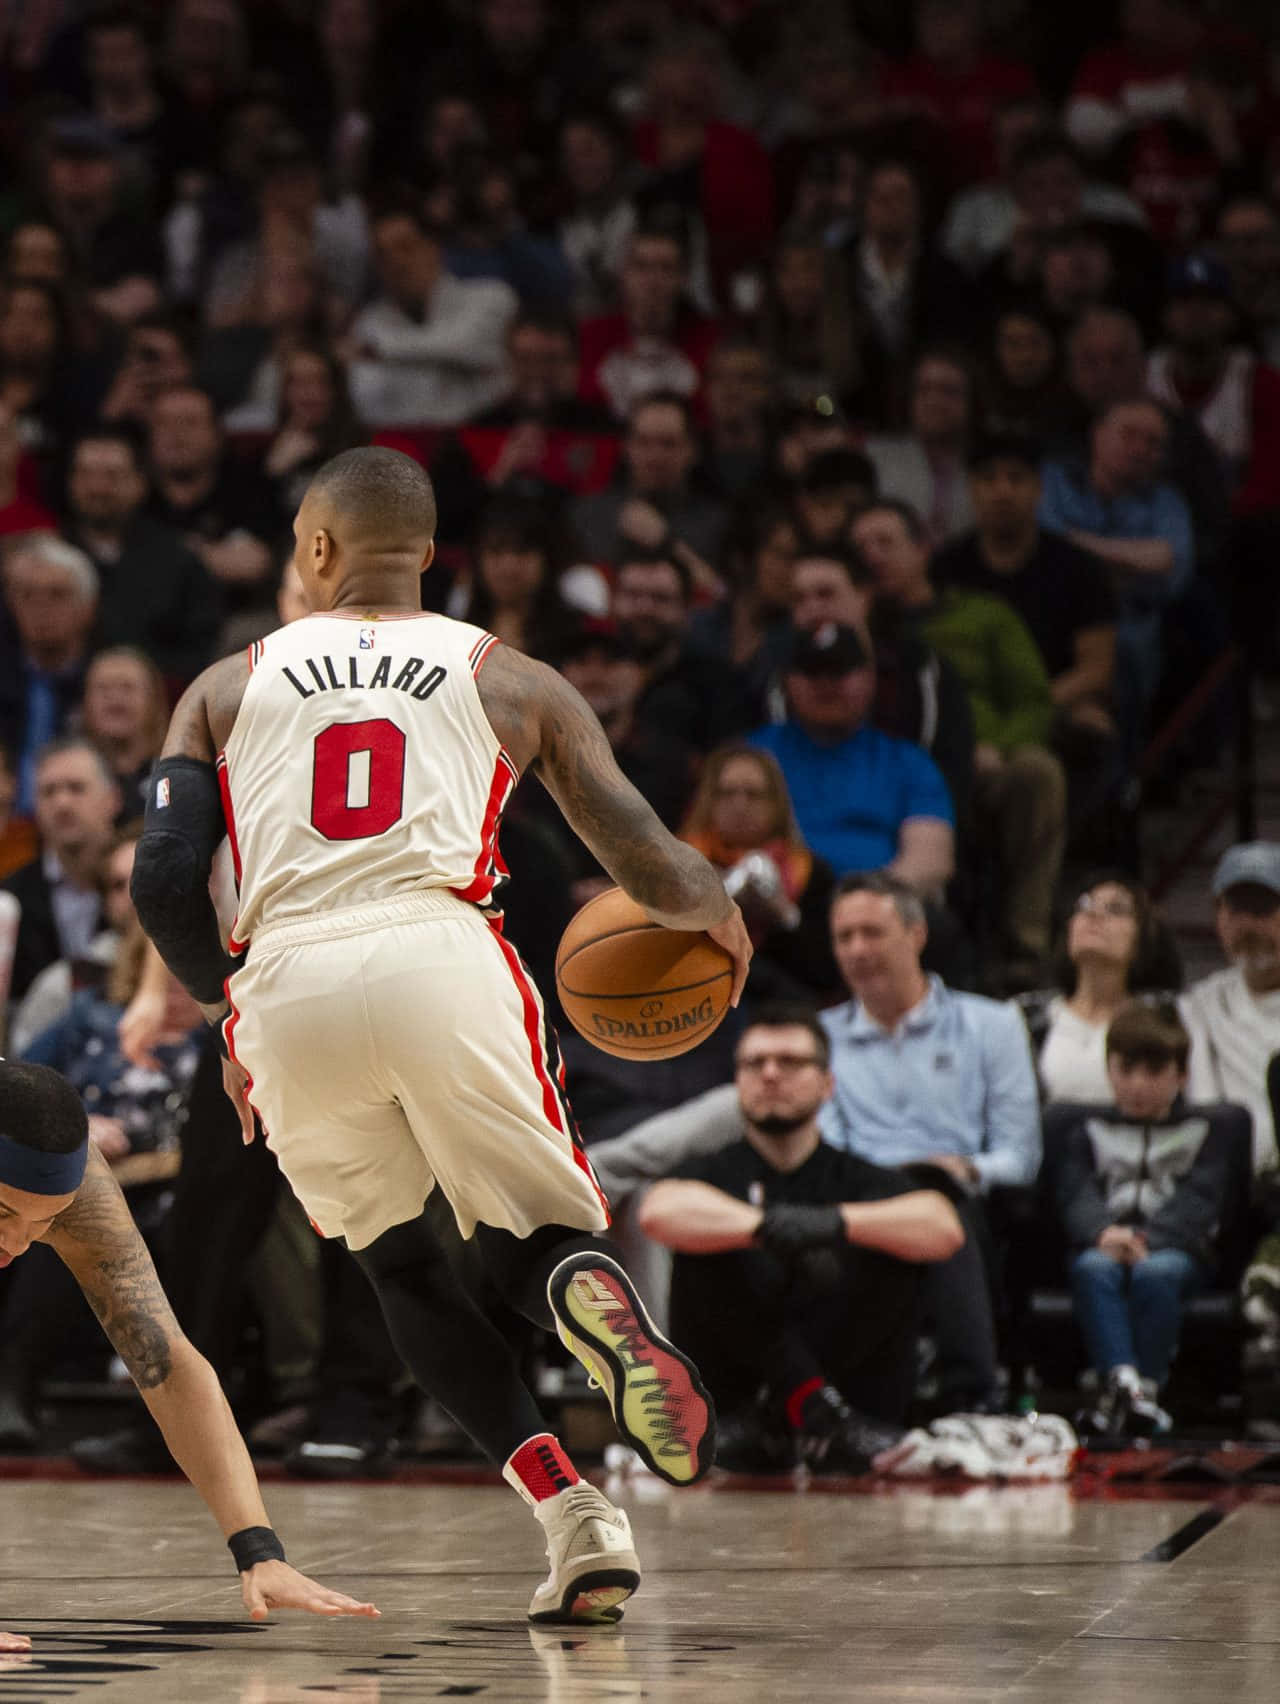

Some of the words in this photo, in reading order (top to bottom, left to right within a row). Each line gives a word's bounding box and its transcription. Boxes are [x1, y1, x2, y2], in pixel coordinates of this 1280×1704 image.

[281, 655, 448, 700] LILLARD
[310, 717, 407, 841] 0
[591, 994, 716, 1038] SPALDING
